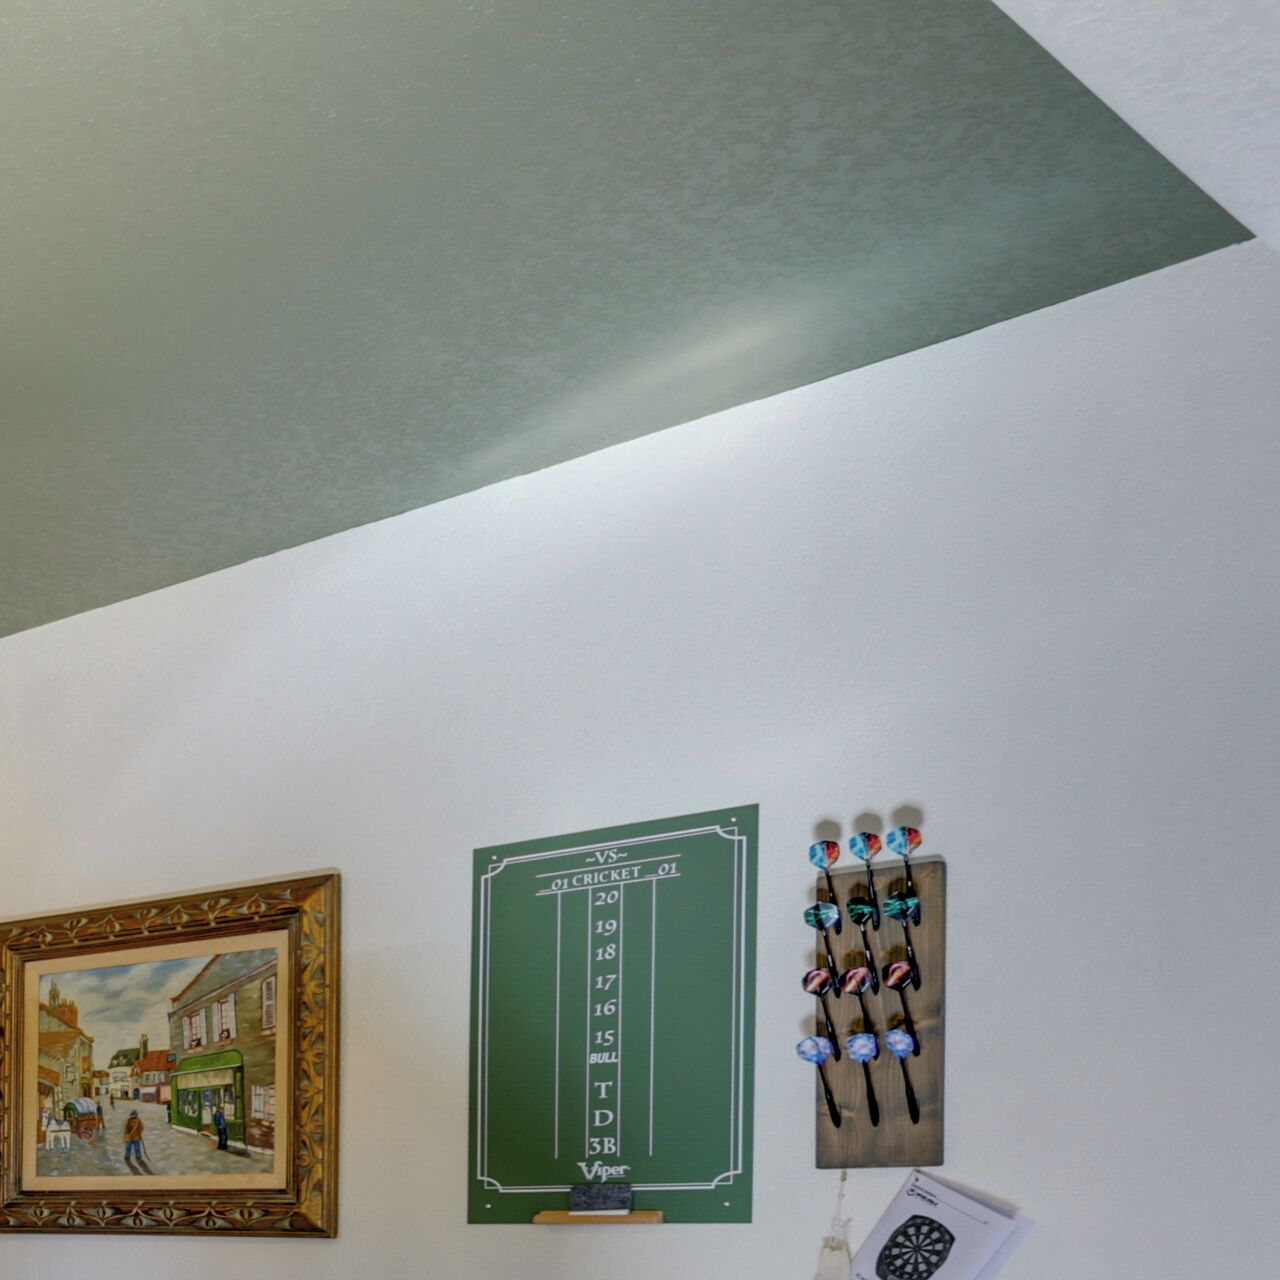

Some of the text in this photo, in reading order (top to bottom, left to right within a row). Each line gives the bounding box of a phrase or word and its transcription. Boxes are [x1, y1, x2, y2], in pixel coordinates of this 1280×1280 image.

[572, 866, 642, 887] CRICKET
[594, 890, 619, 906] 20
[595, 919, 617, 936] 19
[595, 943, 616, 961] 18
[595, 974, 617, 991] 17
[594, 999, 617, 1017] 16
[594, 1030, 615, 1046] 15
[589, 1051, 618, 1064] BULL
[594, 1081, 613, 1099] T
[593, 1109, 614, 1127] D
[588, 1137, 617, 1155] 3B
[577, 1160, 631, 1183] Viper
